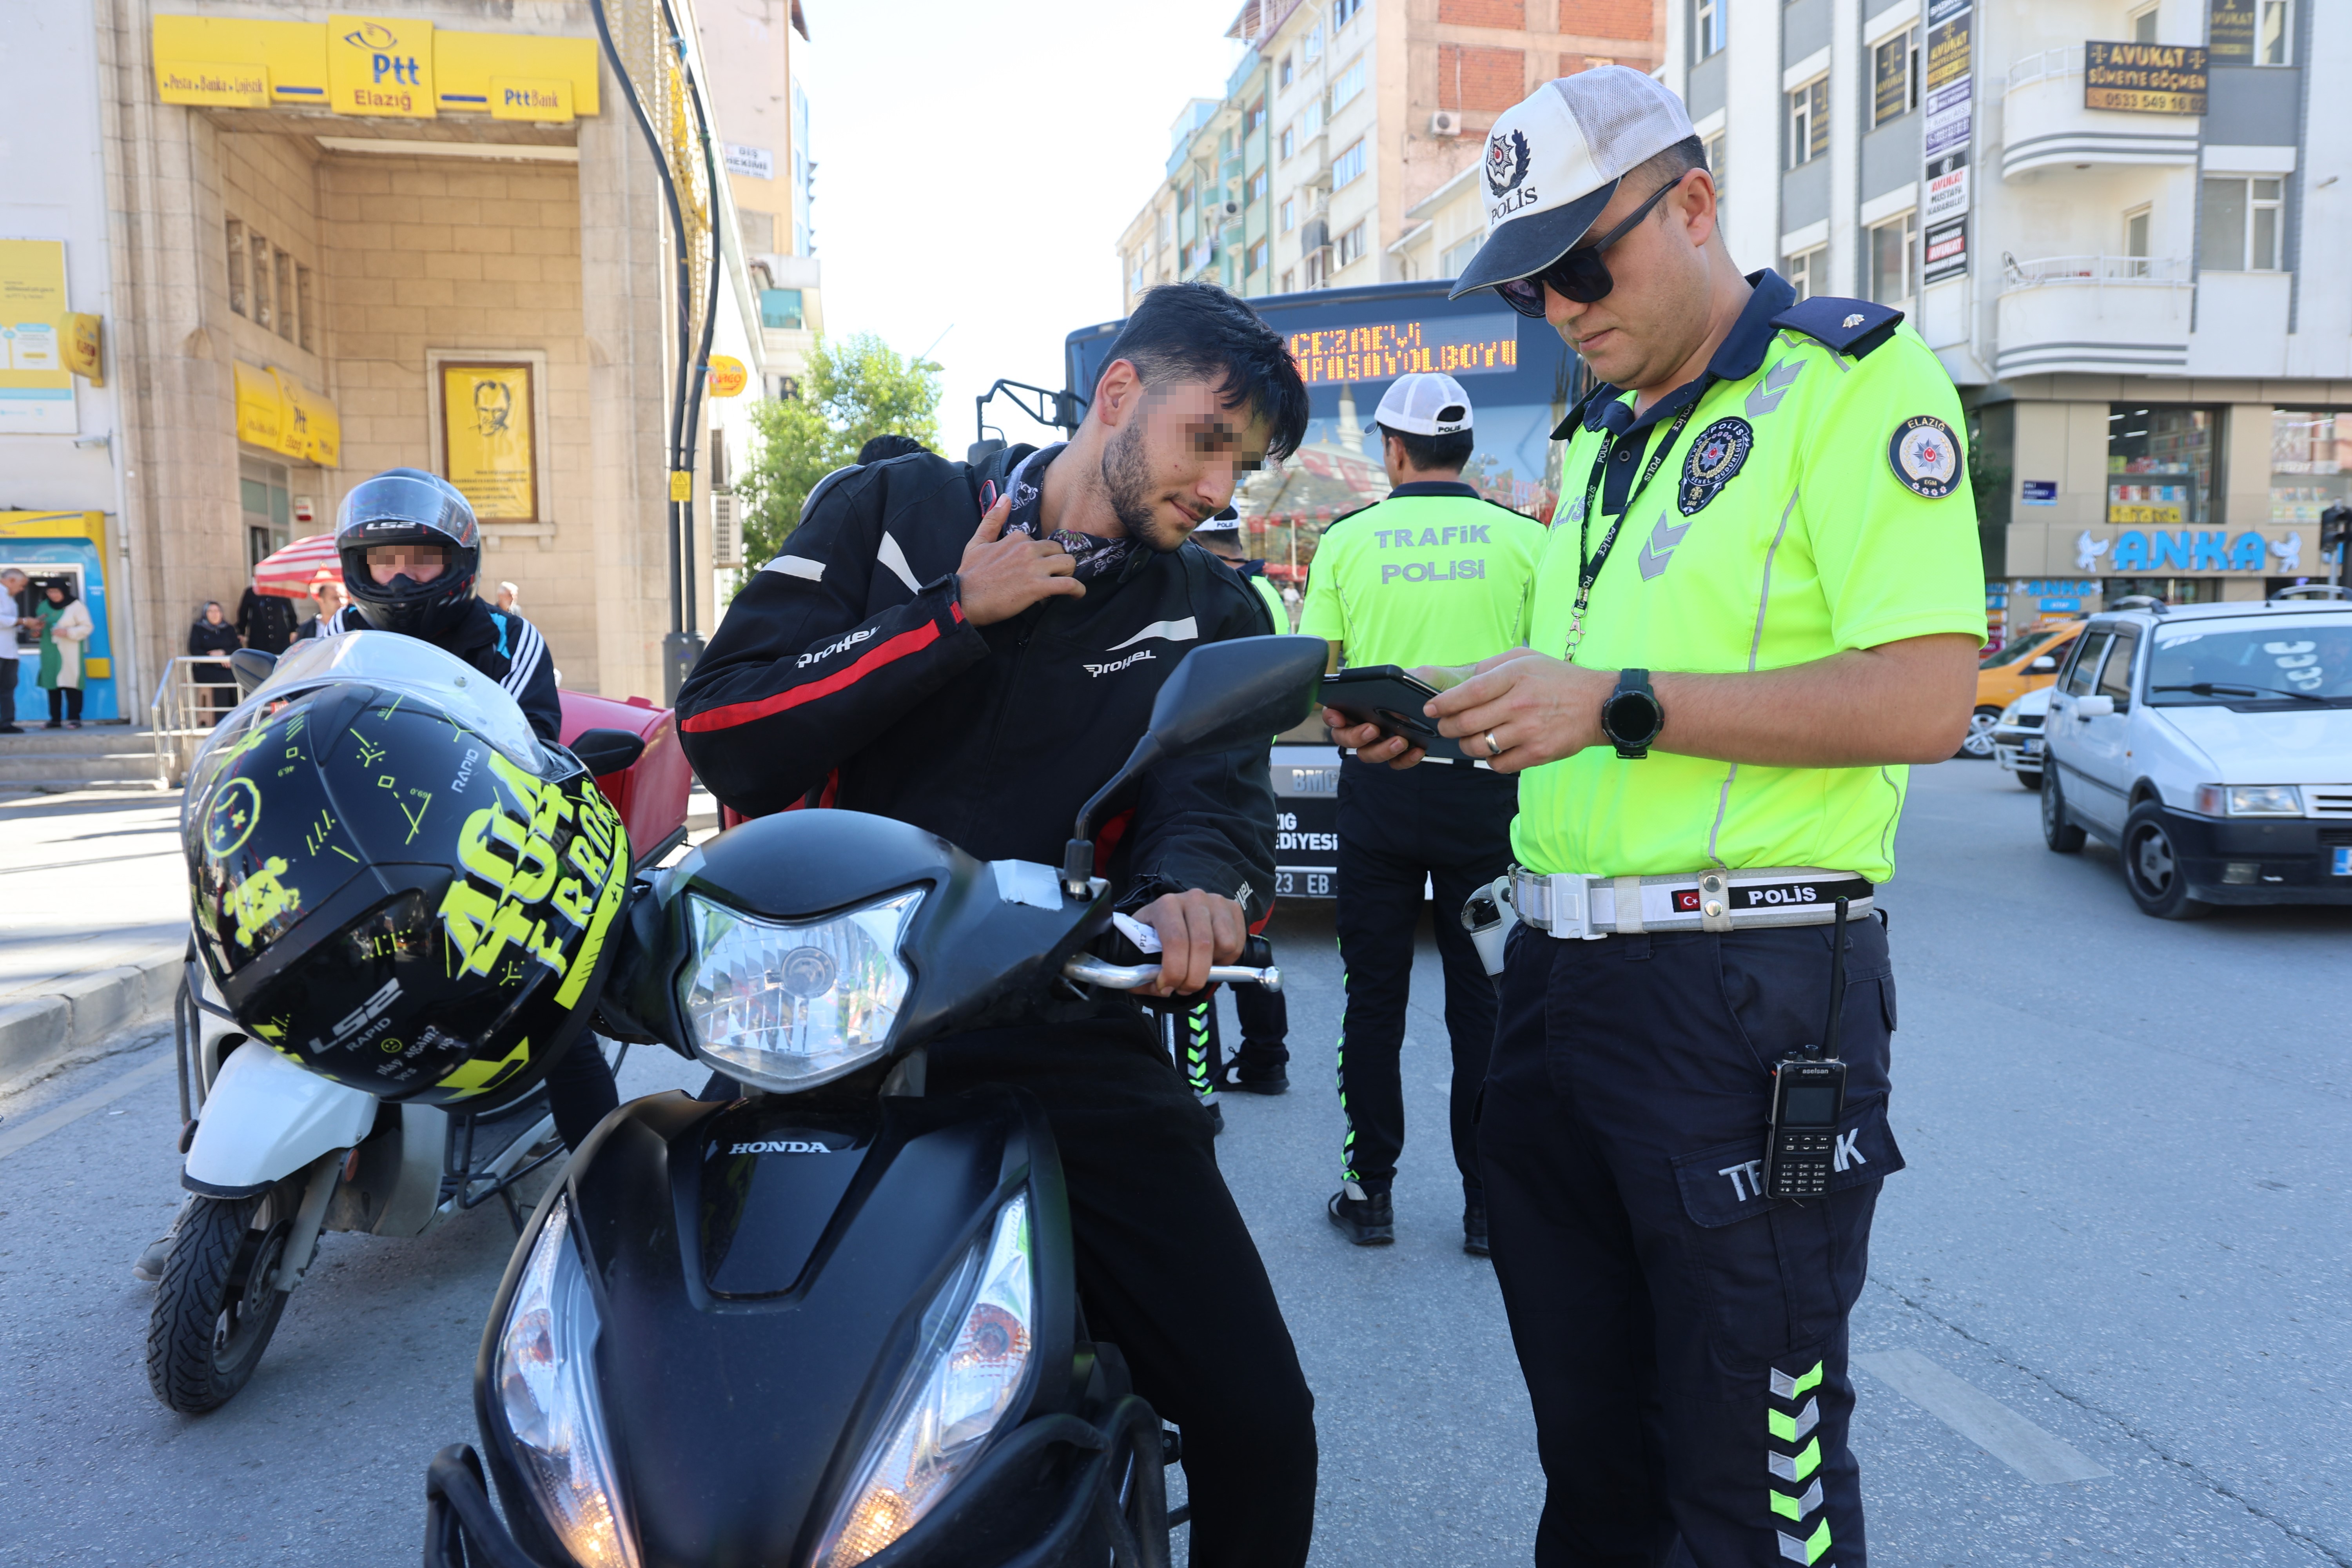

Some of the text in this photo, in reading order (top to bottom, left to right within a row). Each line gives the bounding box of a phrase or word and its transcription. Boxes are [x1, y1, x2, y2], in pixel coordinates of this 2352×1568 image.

[2109, 44, 2186, 68] AVUKAT
[373, 54, 419, 85] Ptt
[2149, 69, 2207, 91] GÖÇMEN
[169, 73, 192, 91] Posta
[200, 75, 227, 93] Banka
[354, 89, 412, 111] Elazığ
[505, 89, 558, 108] PttBank
[1932, 171, 1964, 192] AVUKAT
[1491, 187, 1538, 225] POLİS
[1928, 238, 1963, 261] AVUKAT
[1710, 422, 1744, 436] POLİS
[1907, 417, 1946, 432] ELAZIĞ
[366, 522, 417, 530] LS2
[2113, 530, 2267, 571] ANKA
[2027, 580, 2092, 596] ANKA
[451, 749, 479, 793] RAPID
[1292, 769, 1338, 793] BMC
[1307, 874, 1329, 895] EB
[1748, 885, 1817, 905] POLİS
[308, 977, 404, 1054] LS2
[346, 1017, 391, 1052] RAPID
[729, 1142, 831, 1154] HONDA
